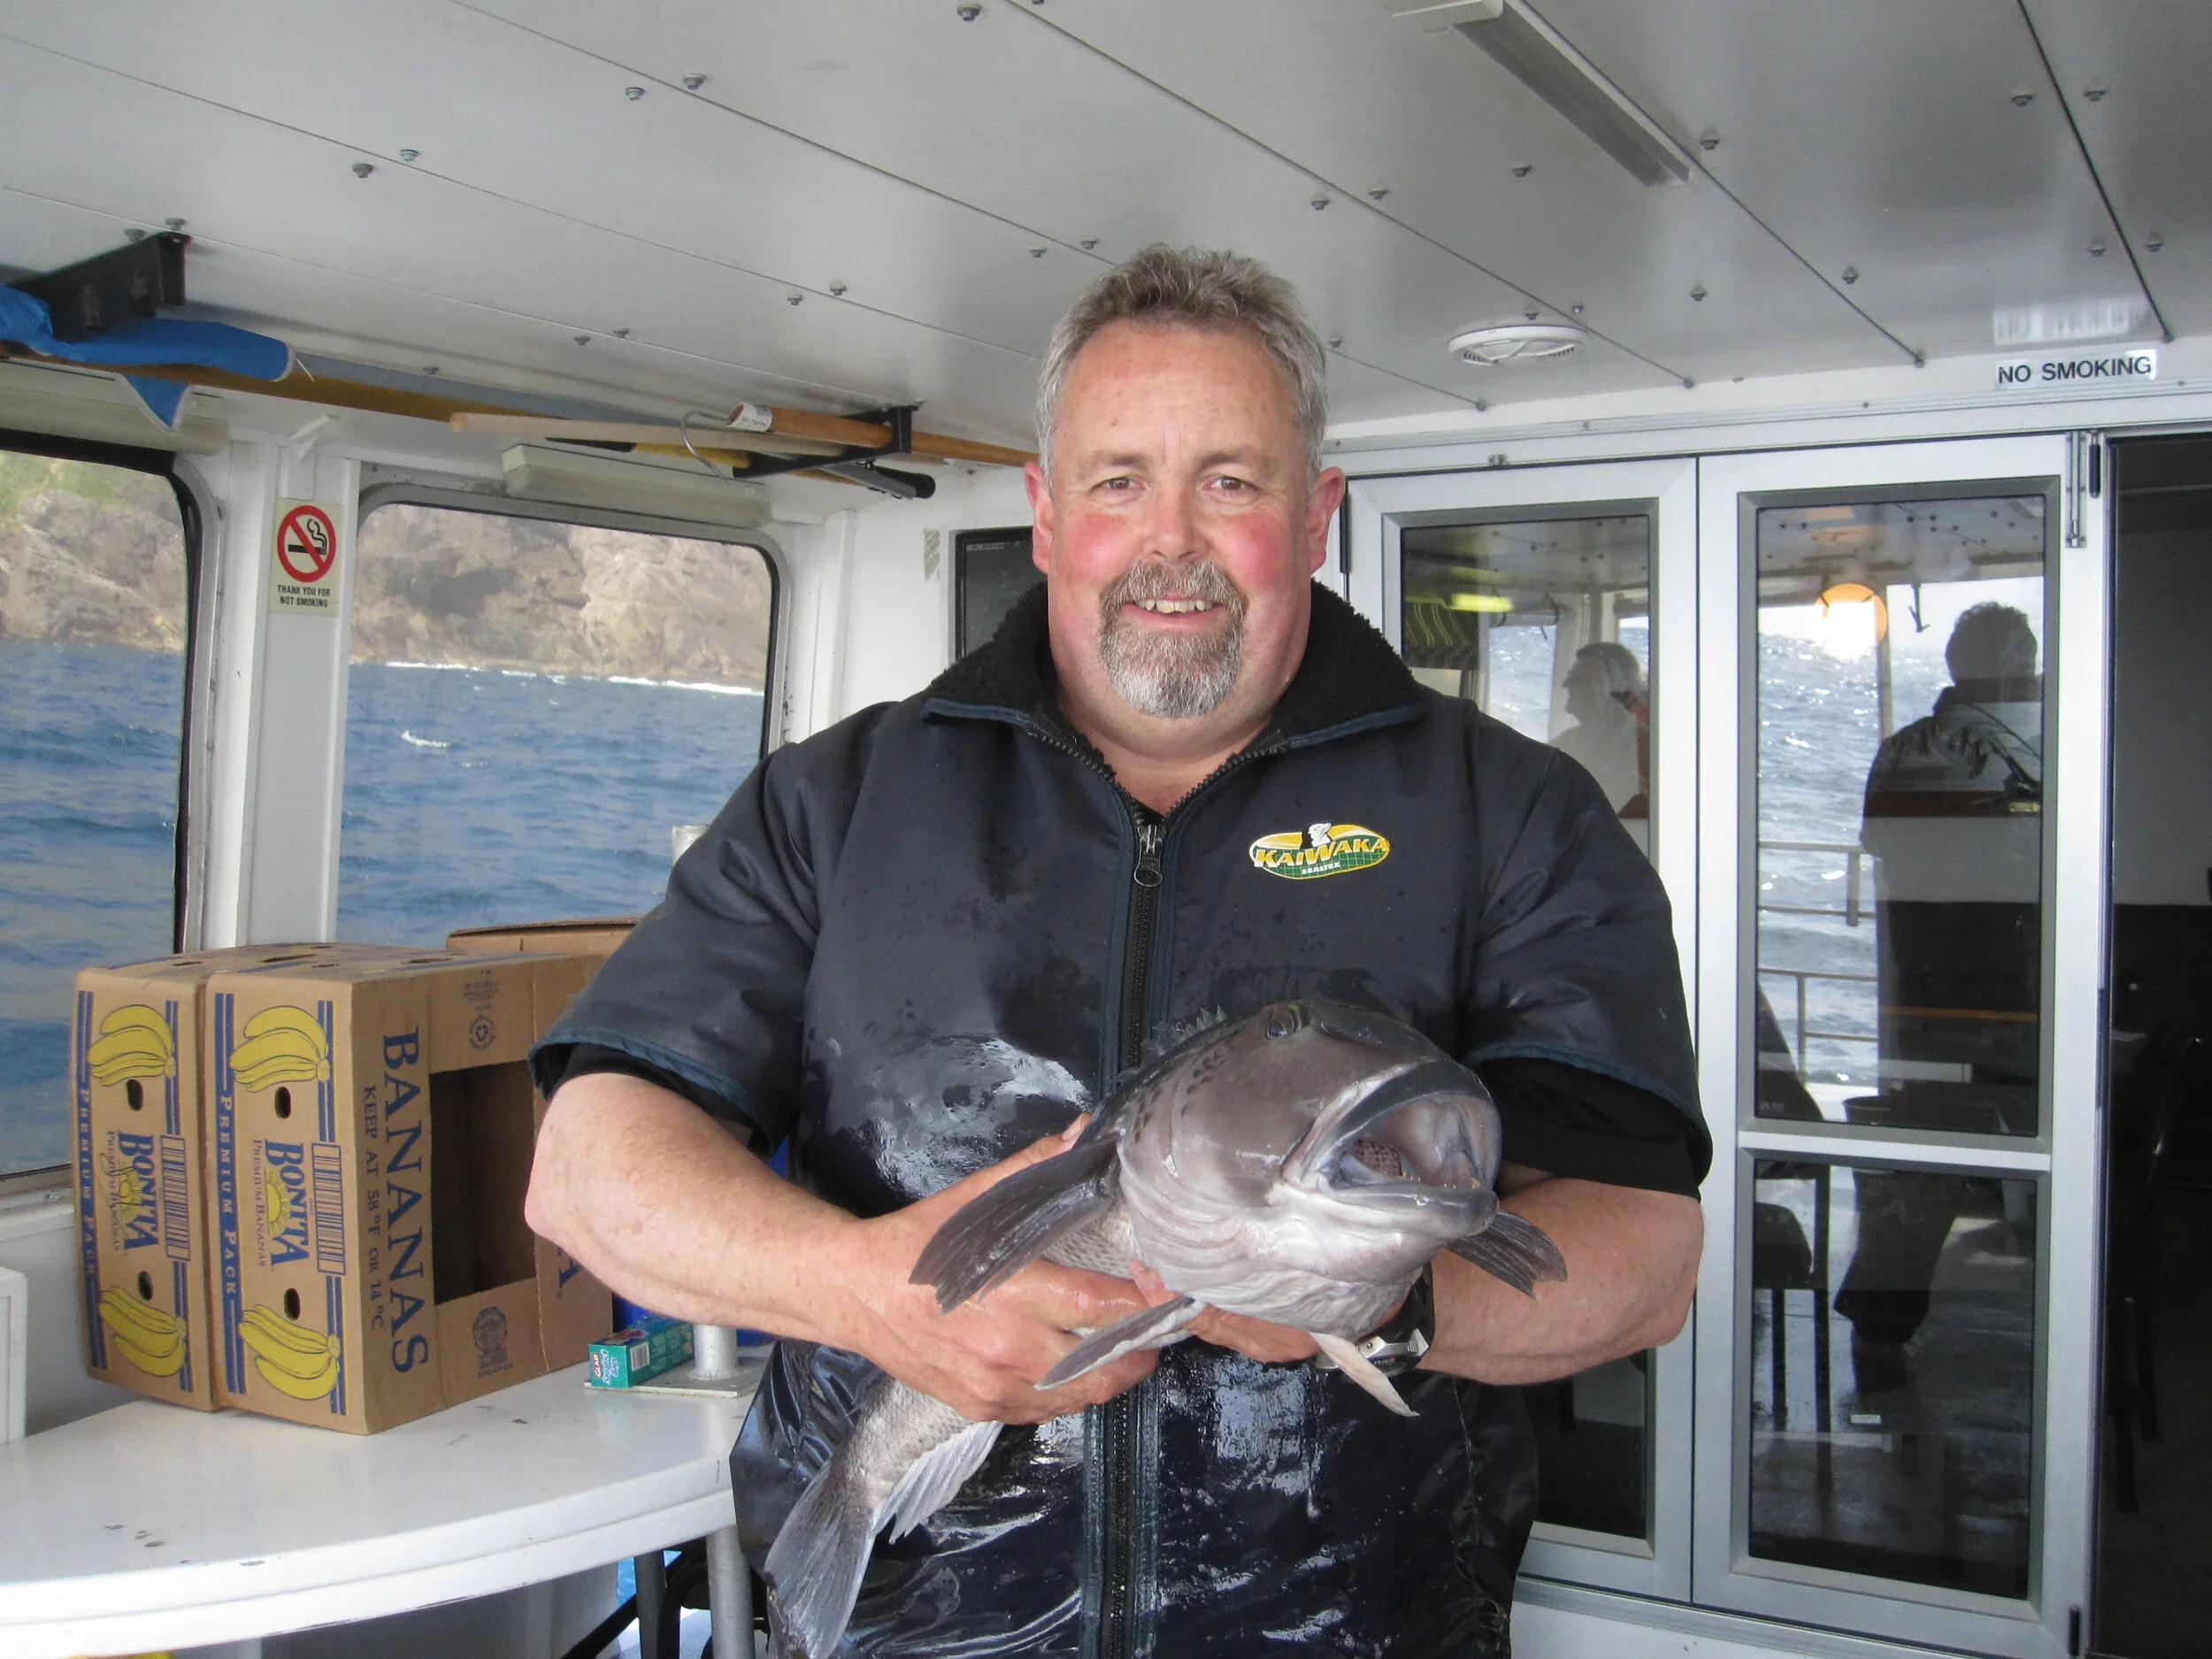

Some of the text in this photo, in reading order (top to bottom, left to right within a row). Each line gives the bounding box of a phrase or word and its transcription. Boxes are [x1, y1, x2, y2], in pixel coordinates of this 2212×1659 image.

[1998, 356, 2152, 384] NO SMOKING
[277, 584, 331, 597] THANK YOU FOR
[280, 595, 328, 608] NOT SMOKING
[1254, 838, 1390, 868] KAIWAKA
[1302, 861, 1341, 875] SEALTEX
[364, 1085, 379, 1139] KEEP
[366, 1149, 380, 1177] AT
[78, 1089, 96, 1277] PREMIUM PACK
[118, 1129, 159, 1251] BONITA
[219, 1096, 238, 1294] PREMIUM PACK
[252, 1139, 266, 1267] PREMIUM BANANAS
[265, 1138, 311, 1266] BONITA
[383, 1025, 429, 1373] BANANAS
[368, 1247, 380, 1273] OR
[593, 1353, 602, 1378] GLAD
